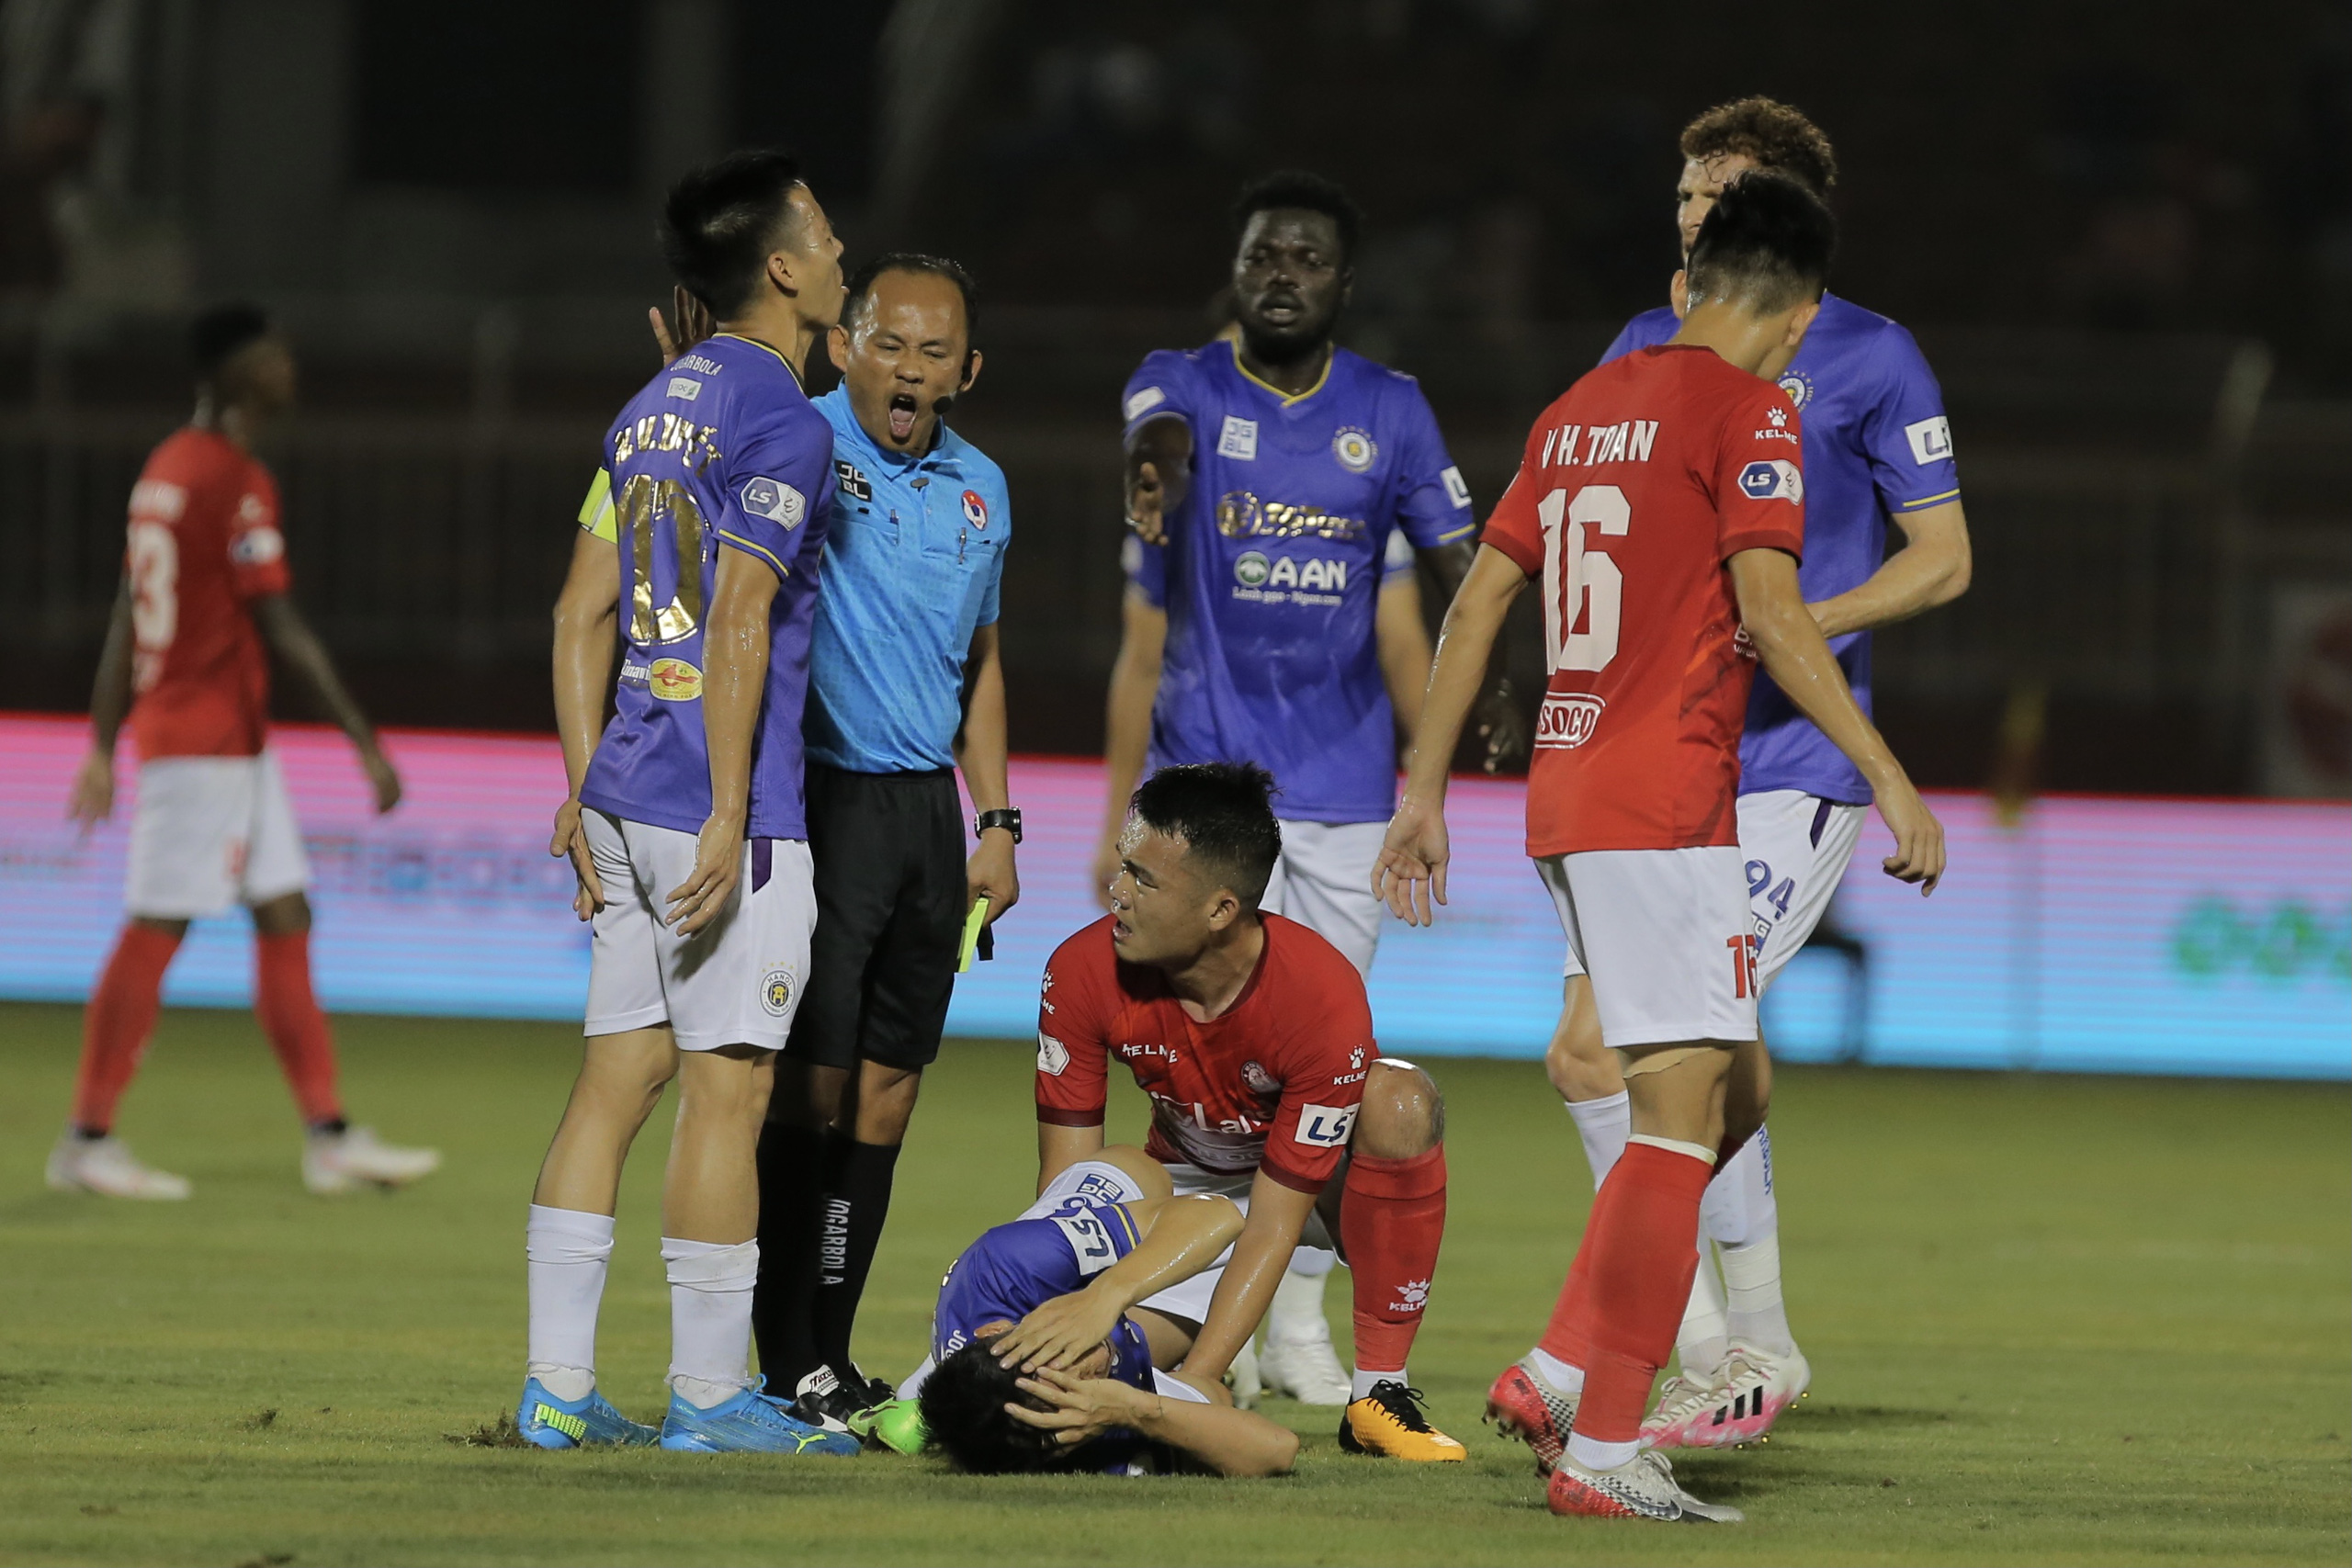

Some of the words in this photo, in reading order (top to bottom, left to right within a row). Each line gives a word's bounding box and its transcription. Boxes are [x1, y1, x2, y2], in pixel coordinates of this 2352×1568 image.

[1755, 429, 1798, 445] KELME
[1747, 473, 1771, 487] LS
[748, 488, 773, 504] LS
[1537, 484, 1632, 676] 16
[1536, 705, 1597, 738] SOCO
[1745, 859, 1796, 920] 94
